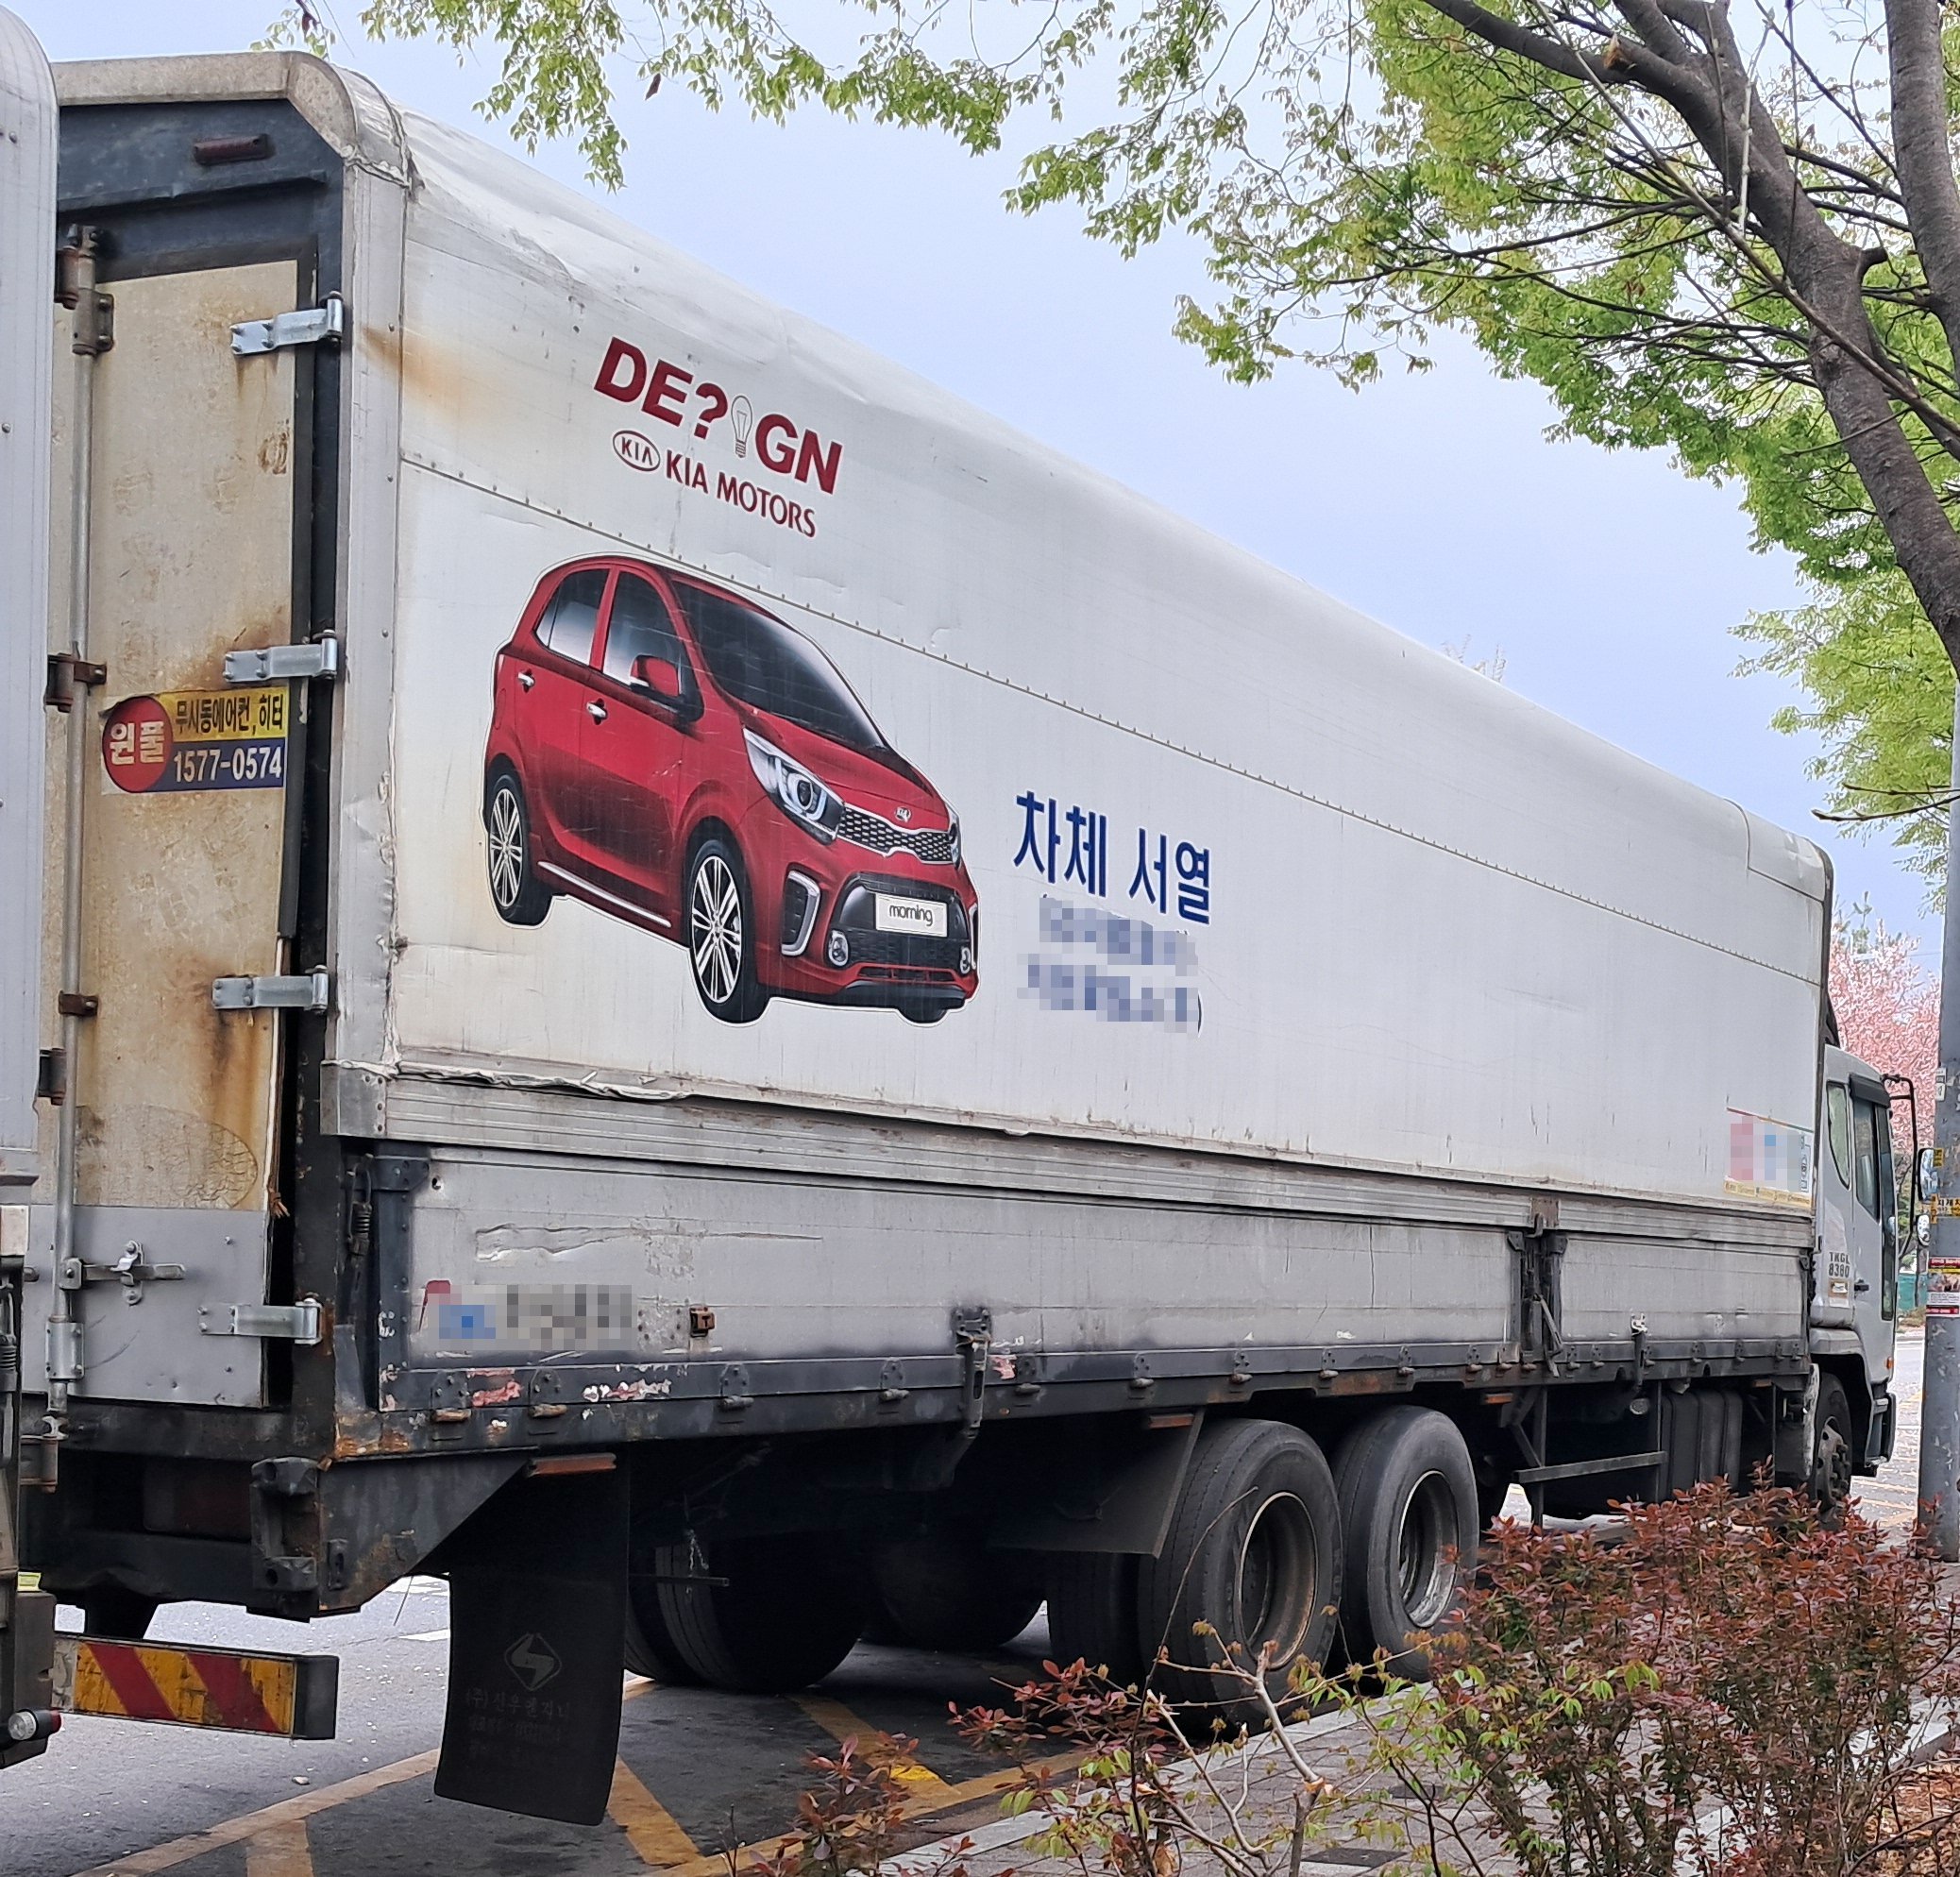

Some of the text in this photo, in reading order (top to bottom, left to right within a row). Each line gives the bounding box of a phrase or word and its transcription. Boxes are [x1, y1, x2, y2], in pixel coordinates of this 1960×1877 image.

[619, 434, 655, 468] KIA
[666, 449, 816, 537] KIA MOTORS
[173, 746, 282, 783] 1577-0574
[1013, 790, 1210, 925] 차체 서열
[888, 904, 934, 927] morning
